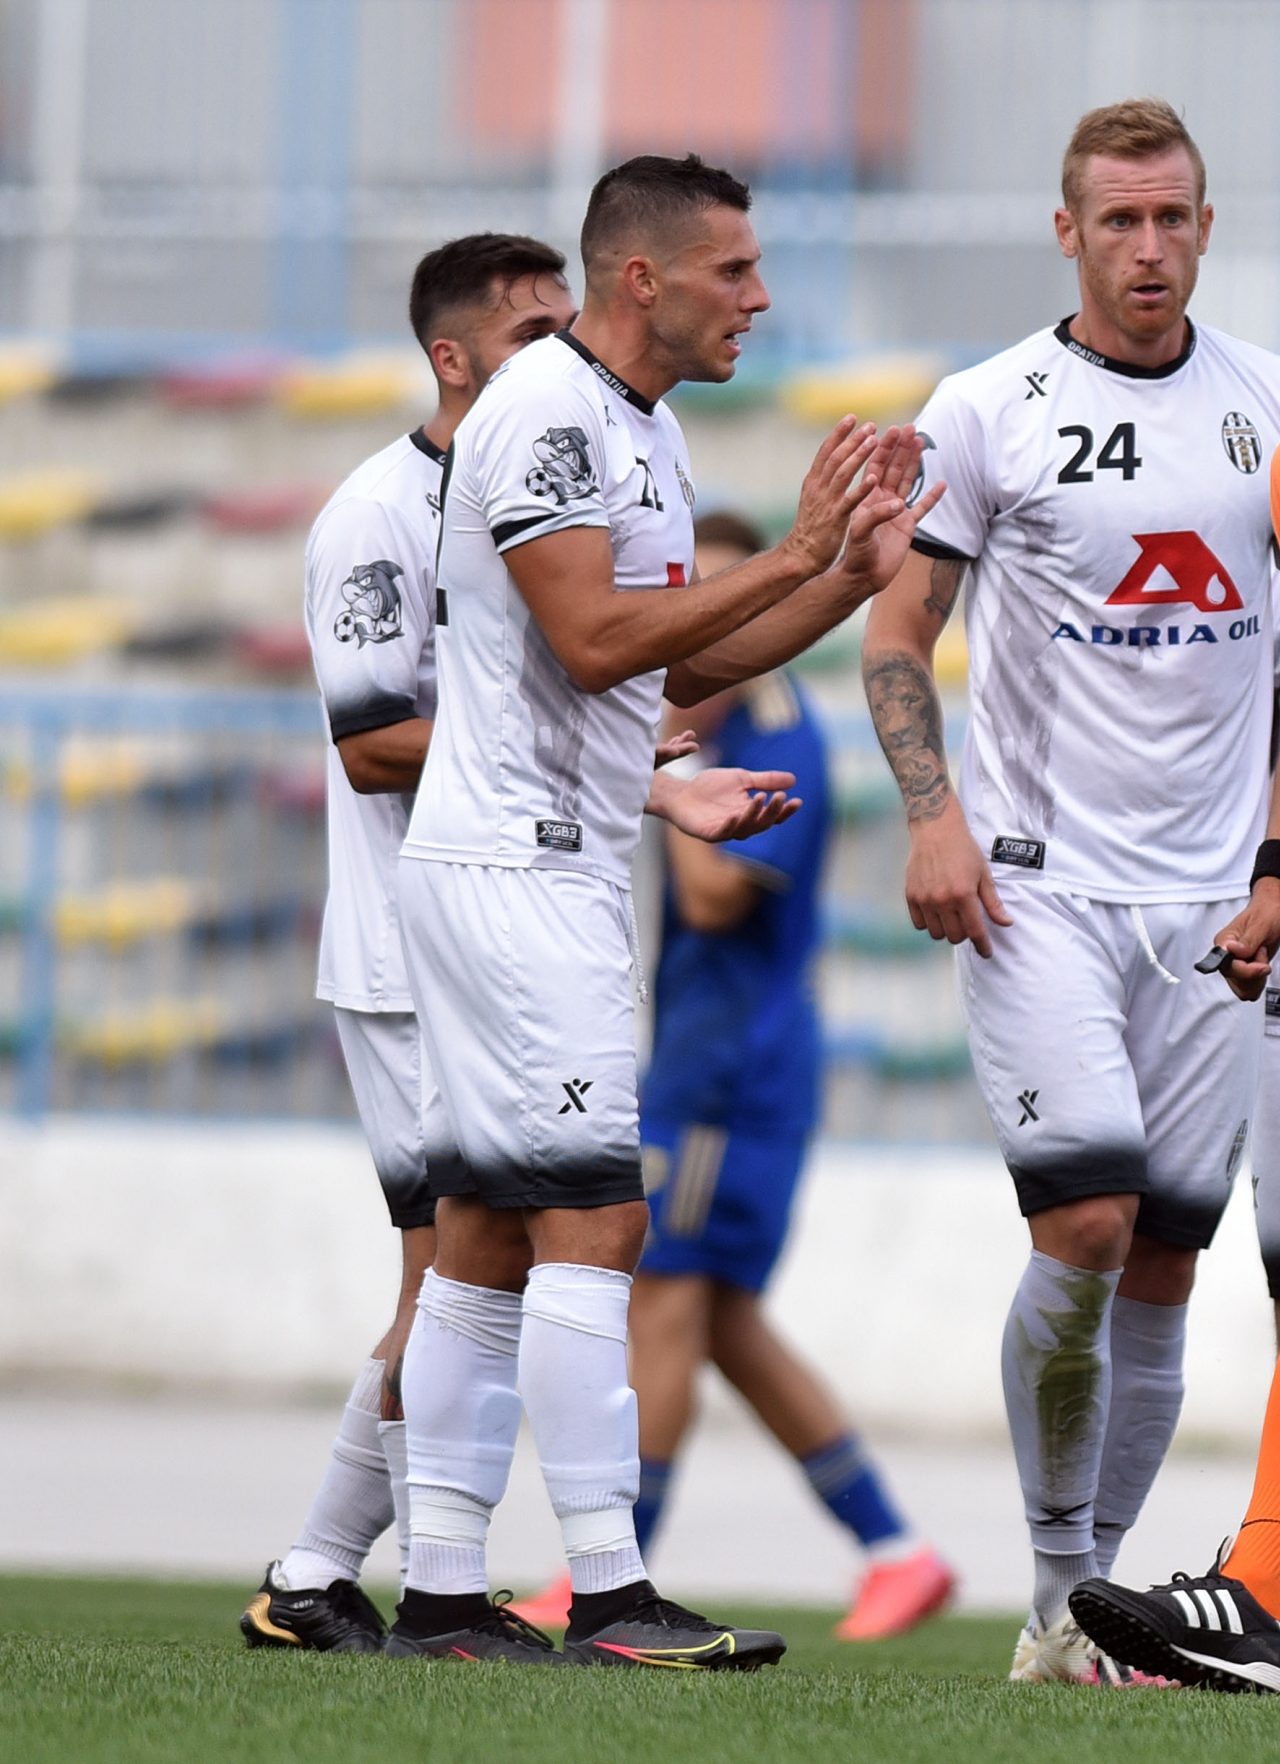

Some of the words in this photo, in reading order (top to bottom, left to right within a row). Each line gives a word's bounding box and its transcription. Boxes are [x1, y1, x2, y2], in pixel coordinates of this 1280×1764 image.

[1067, 341, 1106, 367] OPATIJA
[591, 361, 630, 398] OPATIJA
[1057, 422, 1143, 485] 24
[1051, 621, 1219, 647] ADRIA
[1228, 614, 1262, 641] OIL
